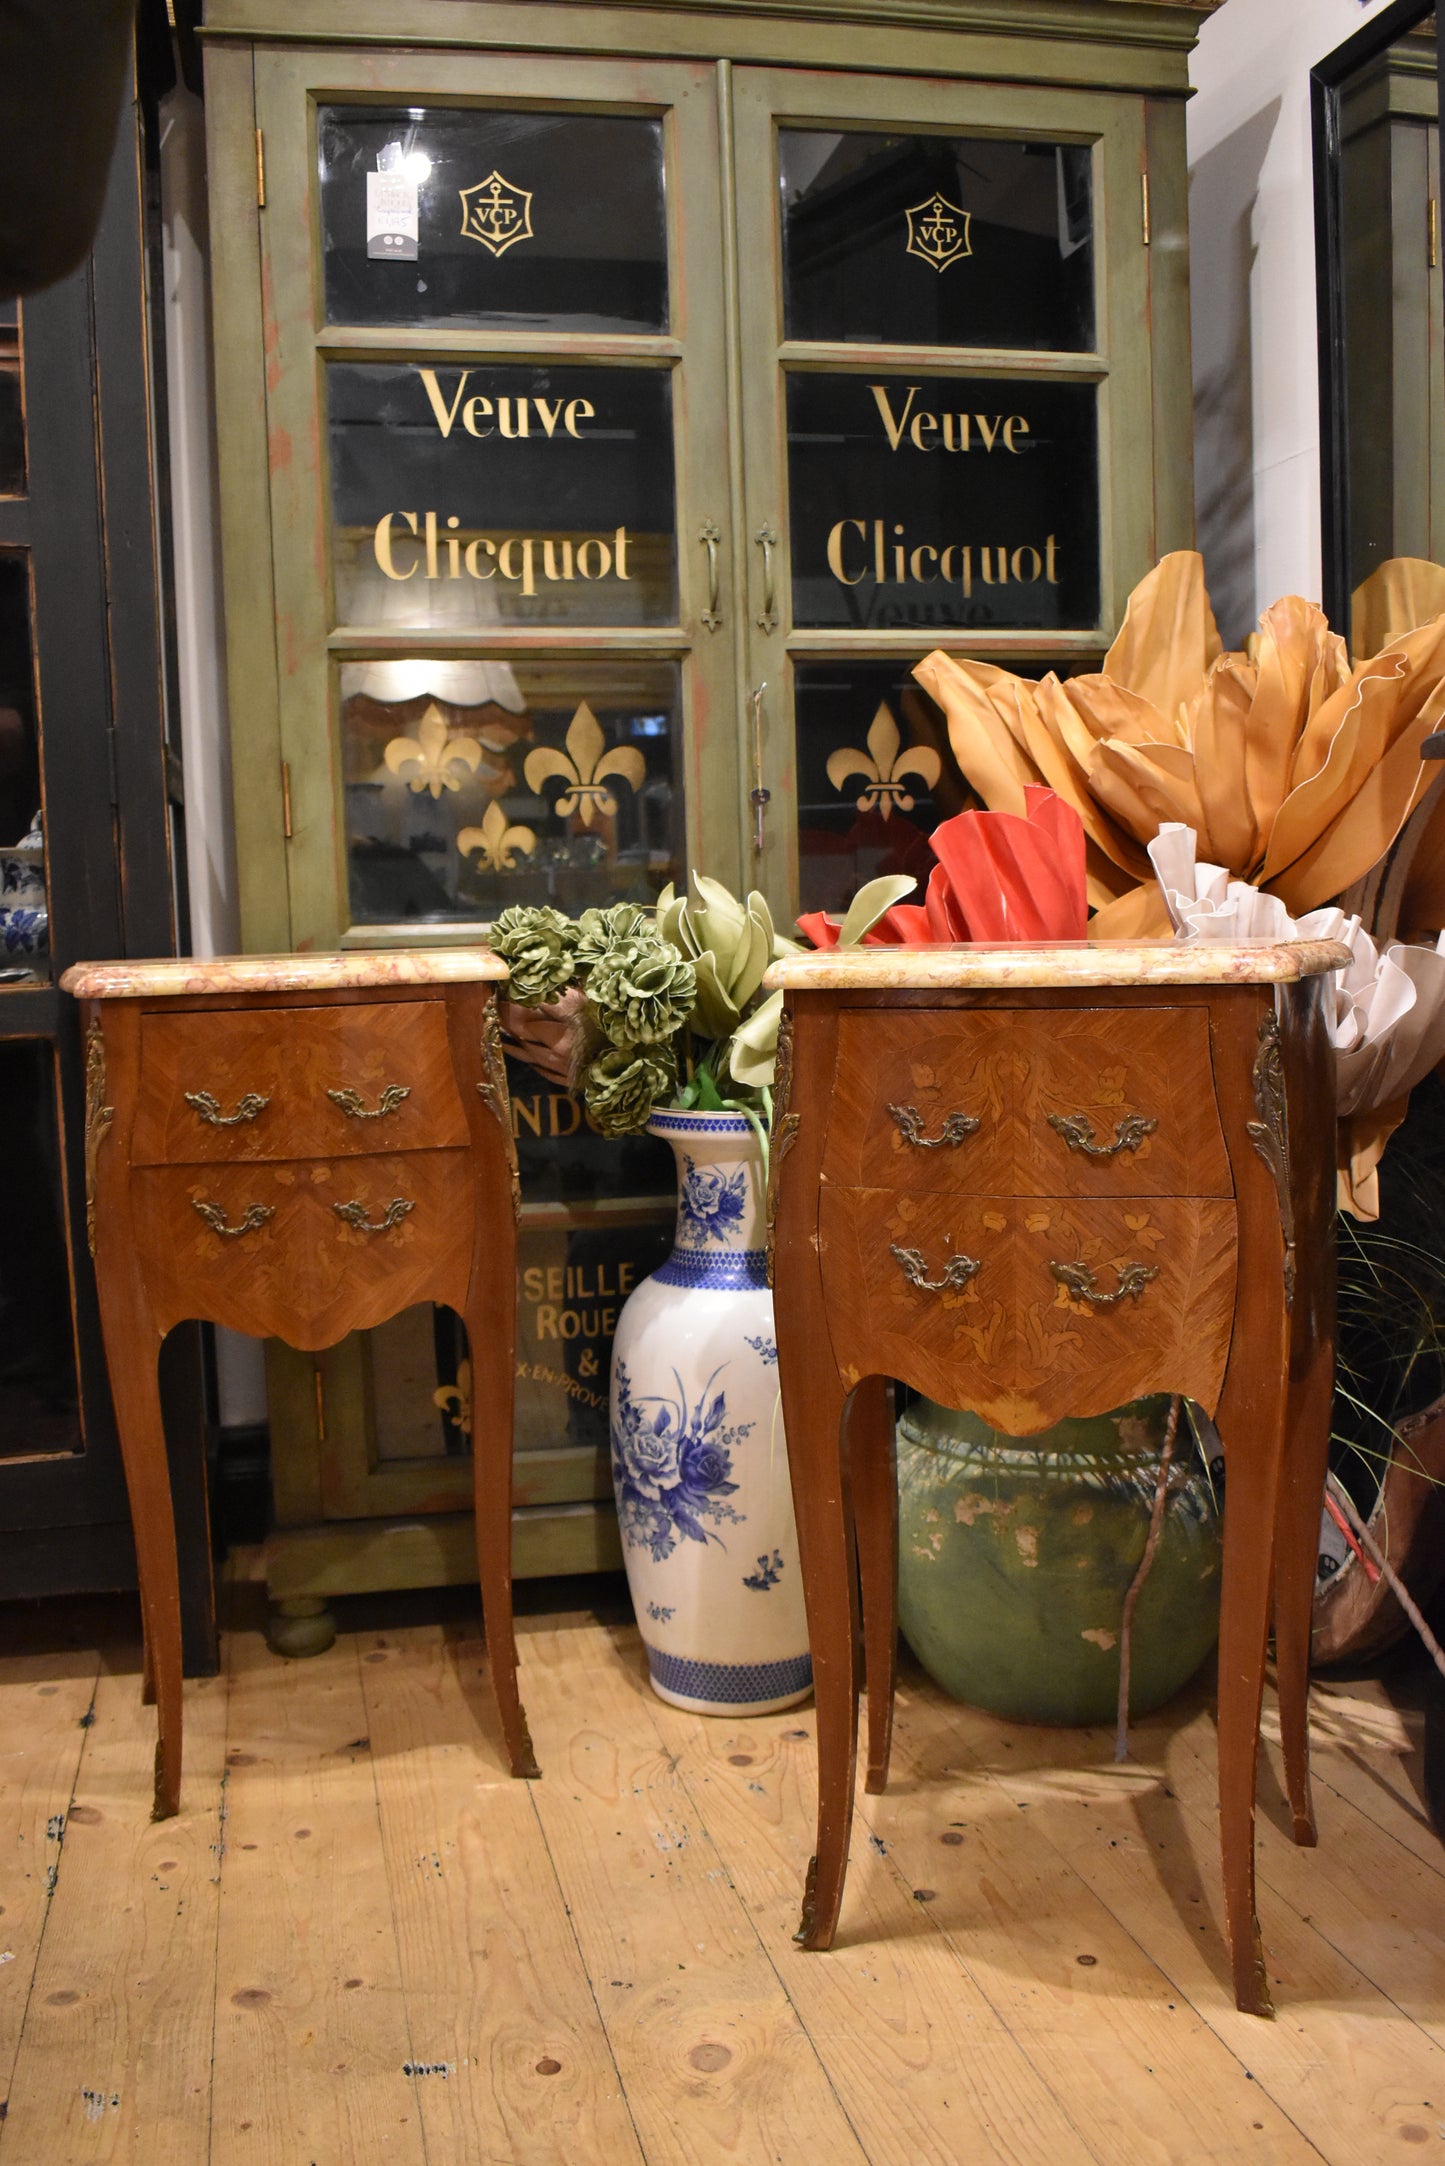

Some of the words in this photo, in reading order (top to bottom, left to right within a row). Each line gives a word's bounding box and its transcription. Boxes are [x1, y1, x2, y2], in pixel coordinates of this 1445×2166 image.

[474, 206, 518, 224] VCP
[919, 226, 958, 243] VCP
[419, 369, 596, 438] Veuve
[870, 386, 1030, 453] Veuve
[374, 510, 633, 597] Clicquot
[827, 518, 1061, 597] Clicquot
[578, 1348, 600, 1377] &
